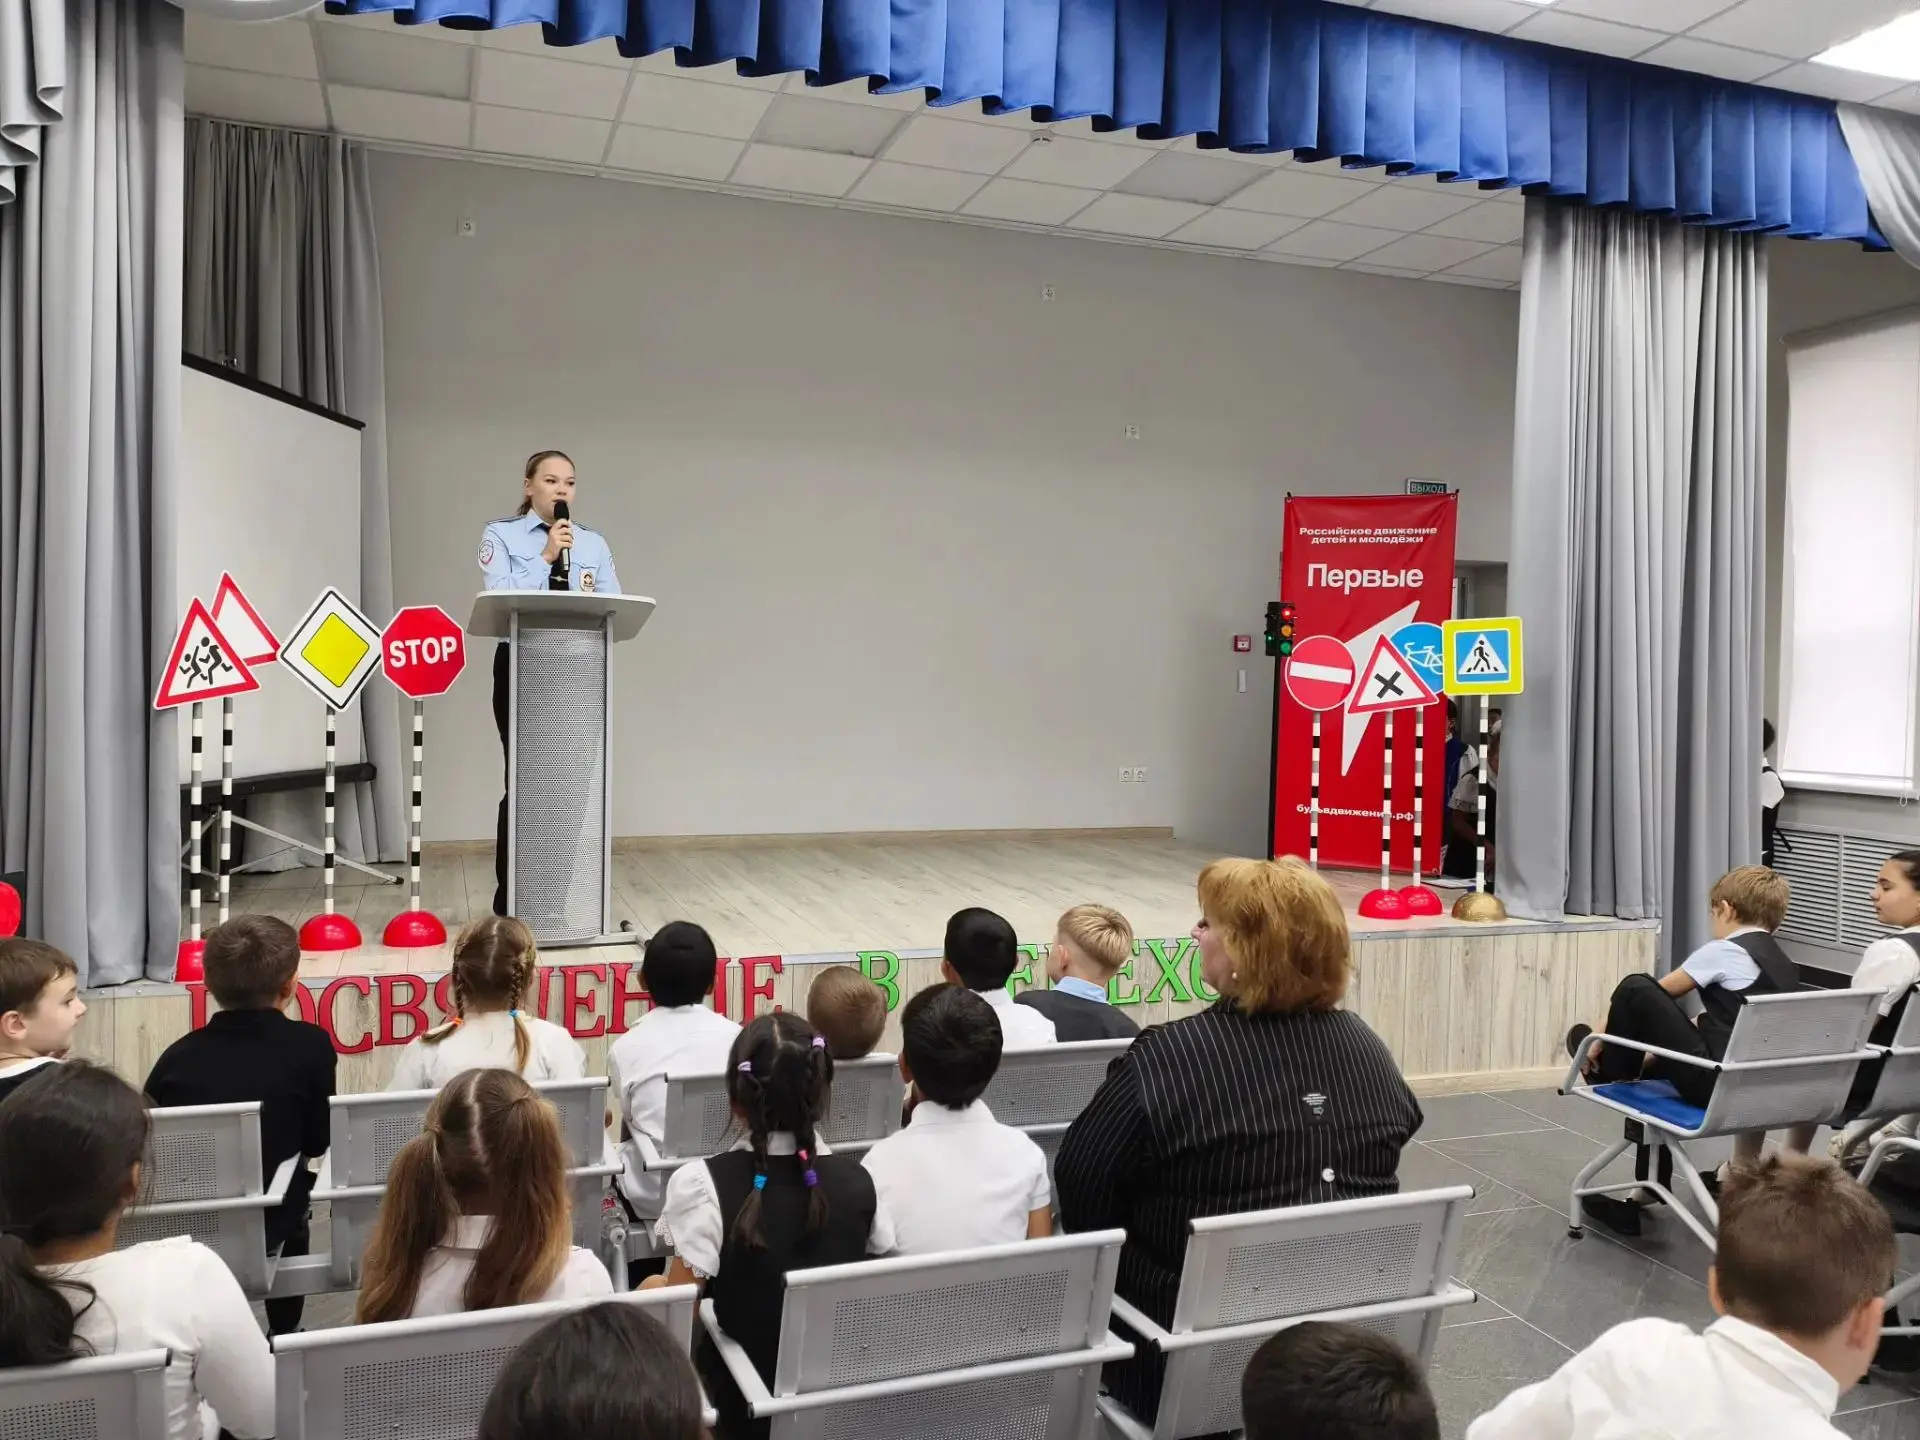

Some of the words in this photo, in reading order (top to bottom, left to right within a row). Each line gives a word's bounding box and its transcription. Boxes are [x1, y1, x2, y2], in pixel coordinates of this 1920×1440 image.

[1410, 483, 1445, 494] ВЫХОД
[1299, 526, 1373, 536] Российское
[1373, 527, 1438, 536] движение
[1311, 535, 1347, 544] детей
[1358, 534, 1424, 545] молодёжи
[1307, 563, 1424, 595] Первые
[389, 636, 457, 668] STOP
